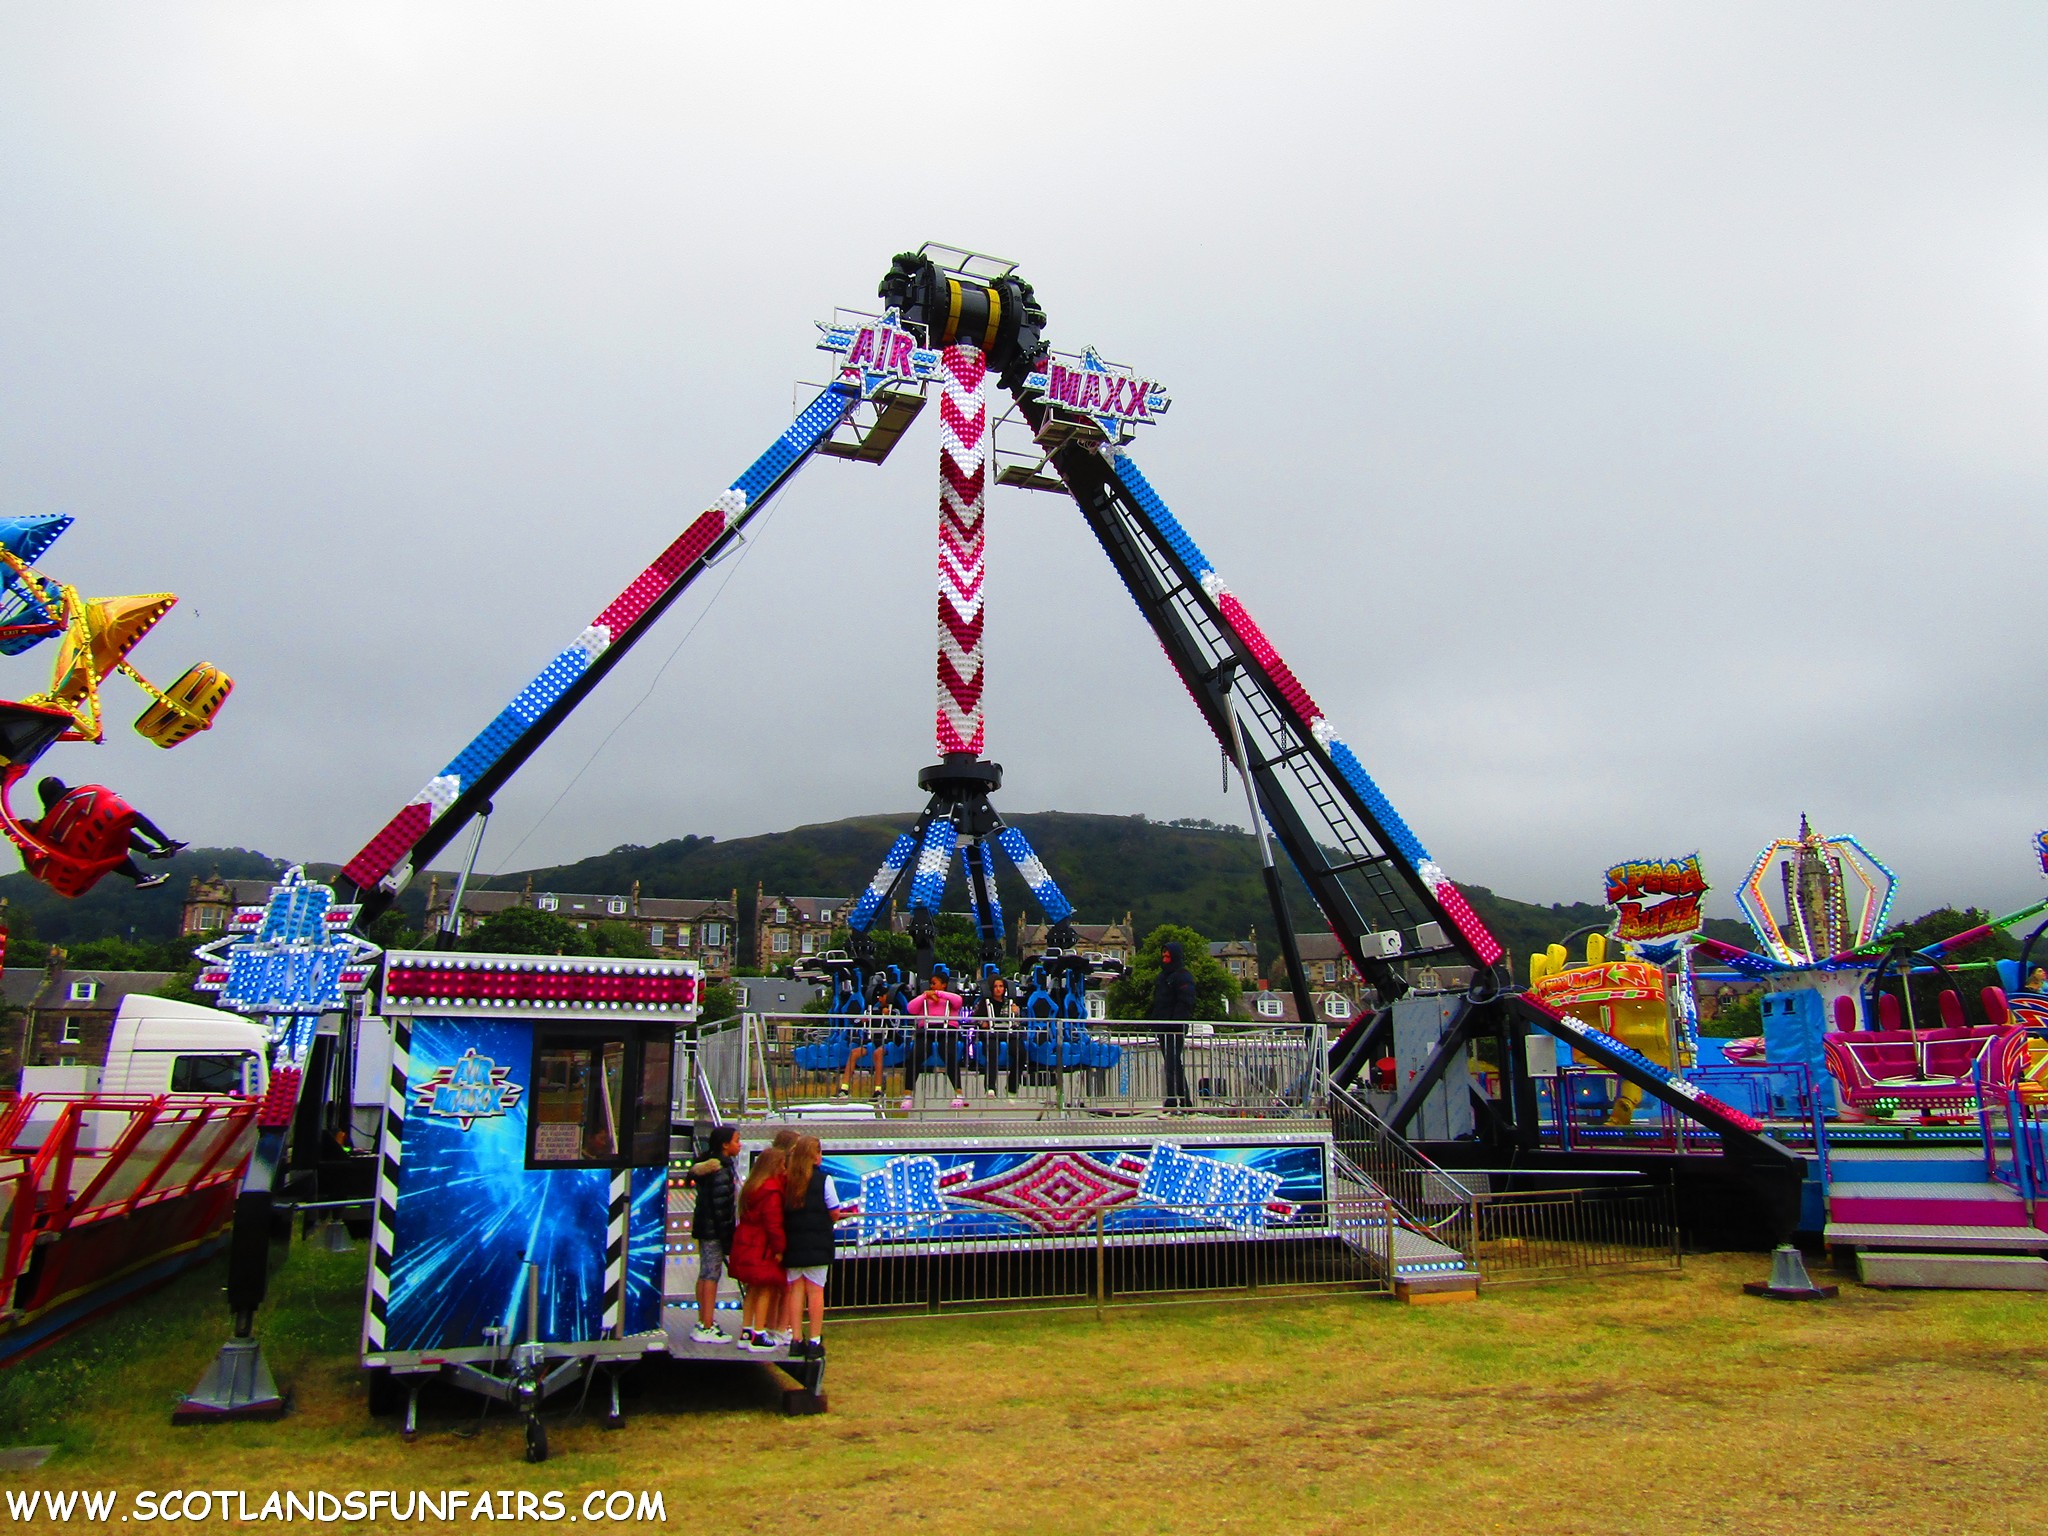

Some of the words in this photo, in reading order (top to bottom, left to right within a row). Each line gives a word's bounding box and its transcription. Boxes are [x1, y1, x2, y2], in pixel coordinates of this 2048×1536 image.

[848, 327, 913, 377] AIR
[1048, 364, 1150, 417] MAXX
[259, 886, 331, 946] AIR
[222, 949, 350, 1005] MAXX
[451, 1057, 492, 1086] AIR
[432, 1086, 507, 1113] MAXX
[862, 1161, 942, 1237] AIR
[1145, 1145, 1276, 1228] MAXX
